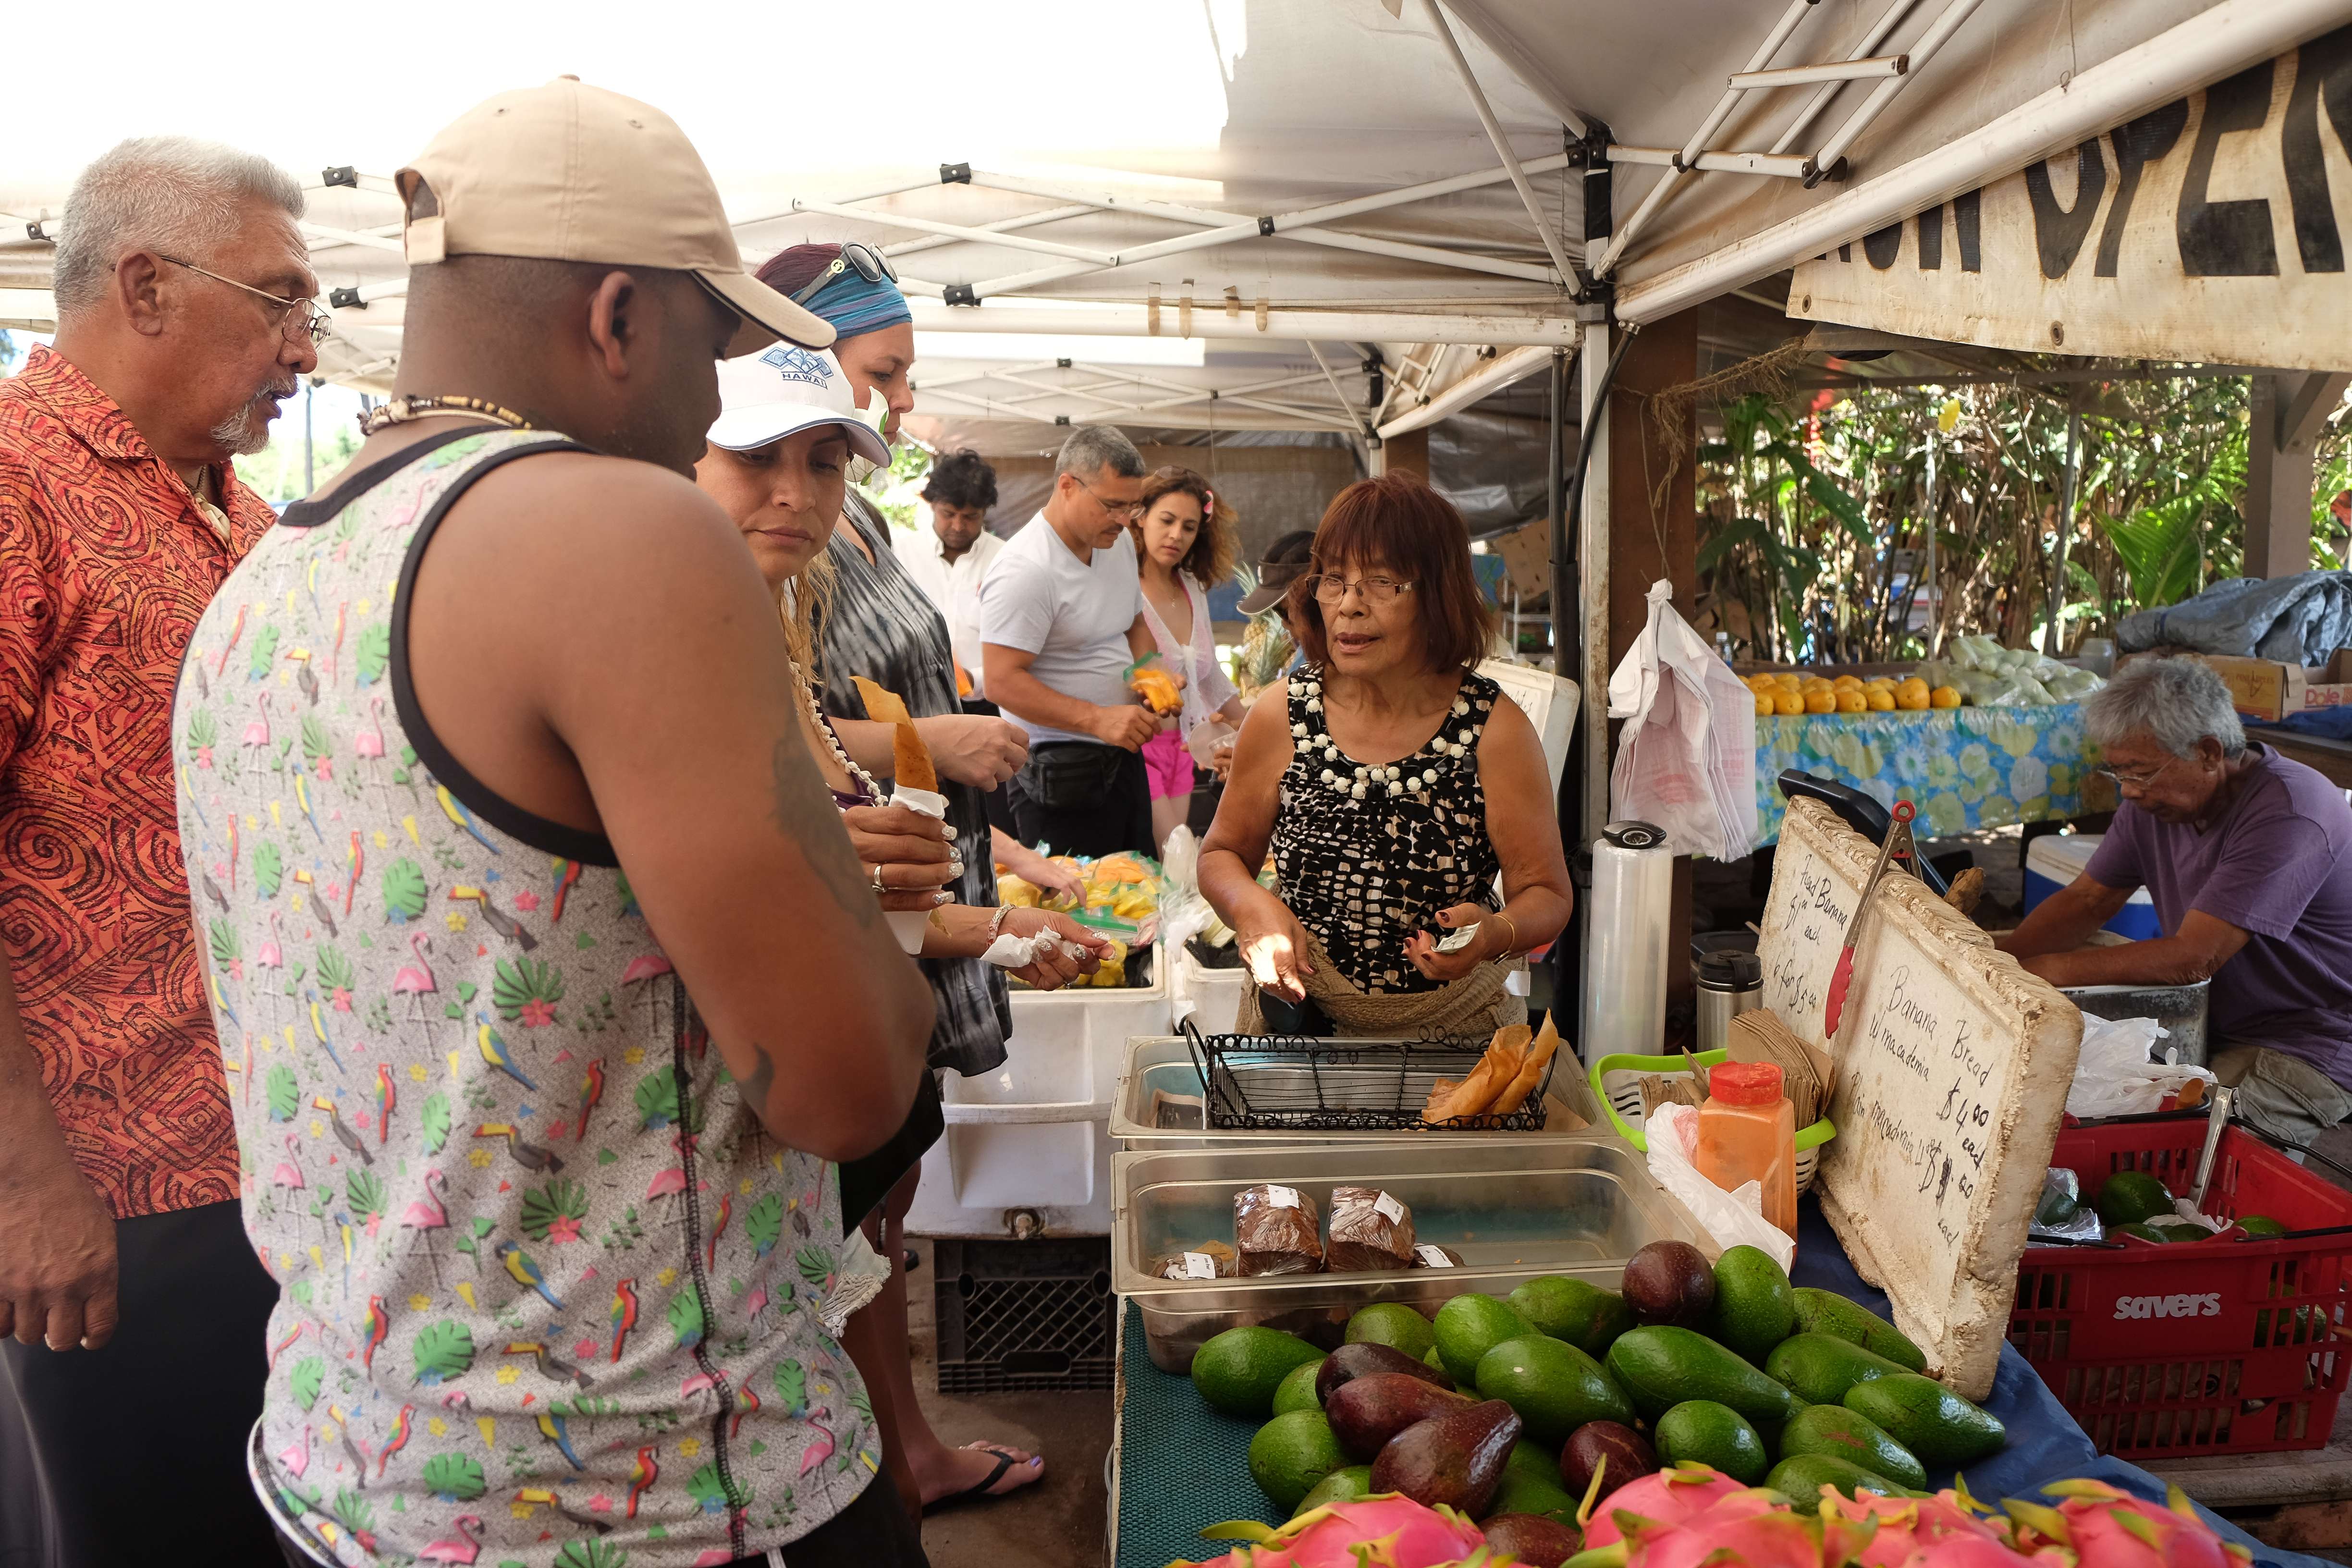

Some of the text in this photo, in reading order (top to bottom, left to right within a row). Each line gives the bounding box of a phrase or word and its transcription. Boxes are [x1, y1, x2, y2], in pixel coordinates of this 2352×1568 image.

[2306, 687, 2340, 705] Dole
[1814, 877, 1848, 931] Banana
[1886, 965, 1994, 1088] Banana Bread
[2113, 1293, 2221, 1320] savers
